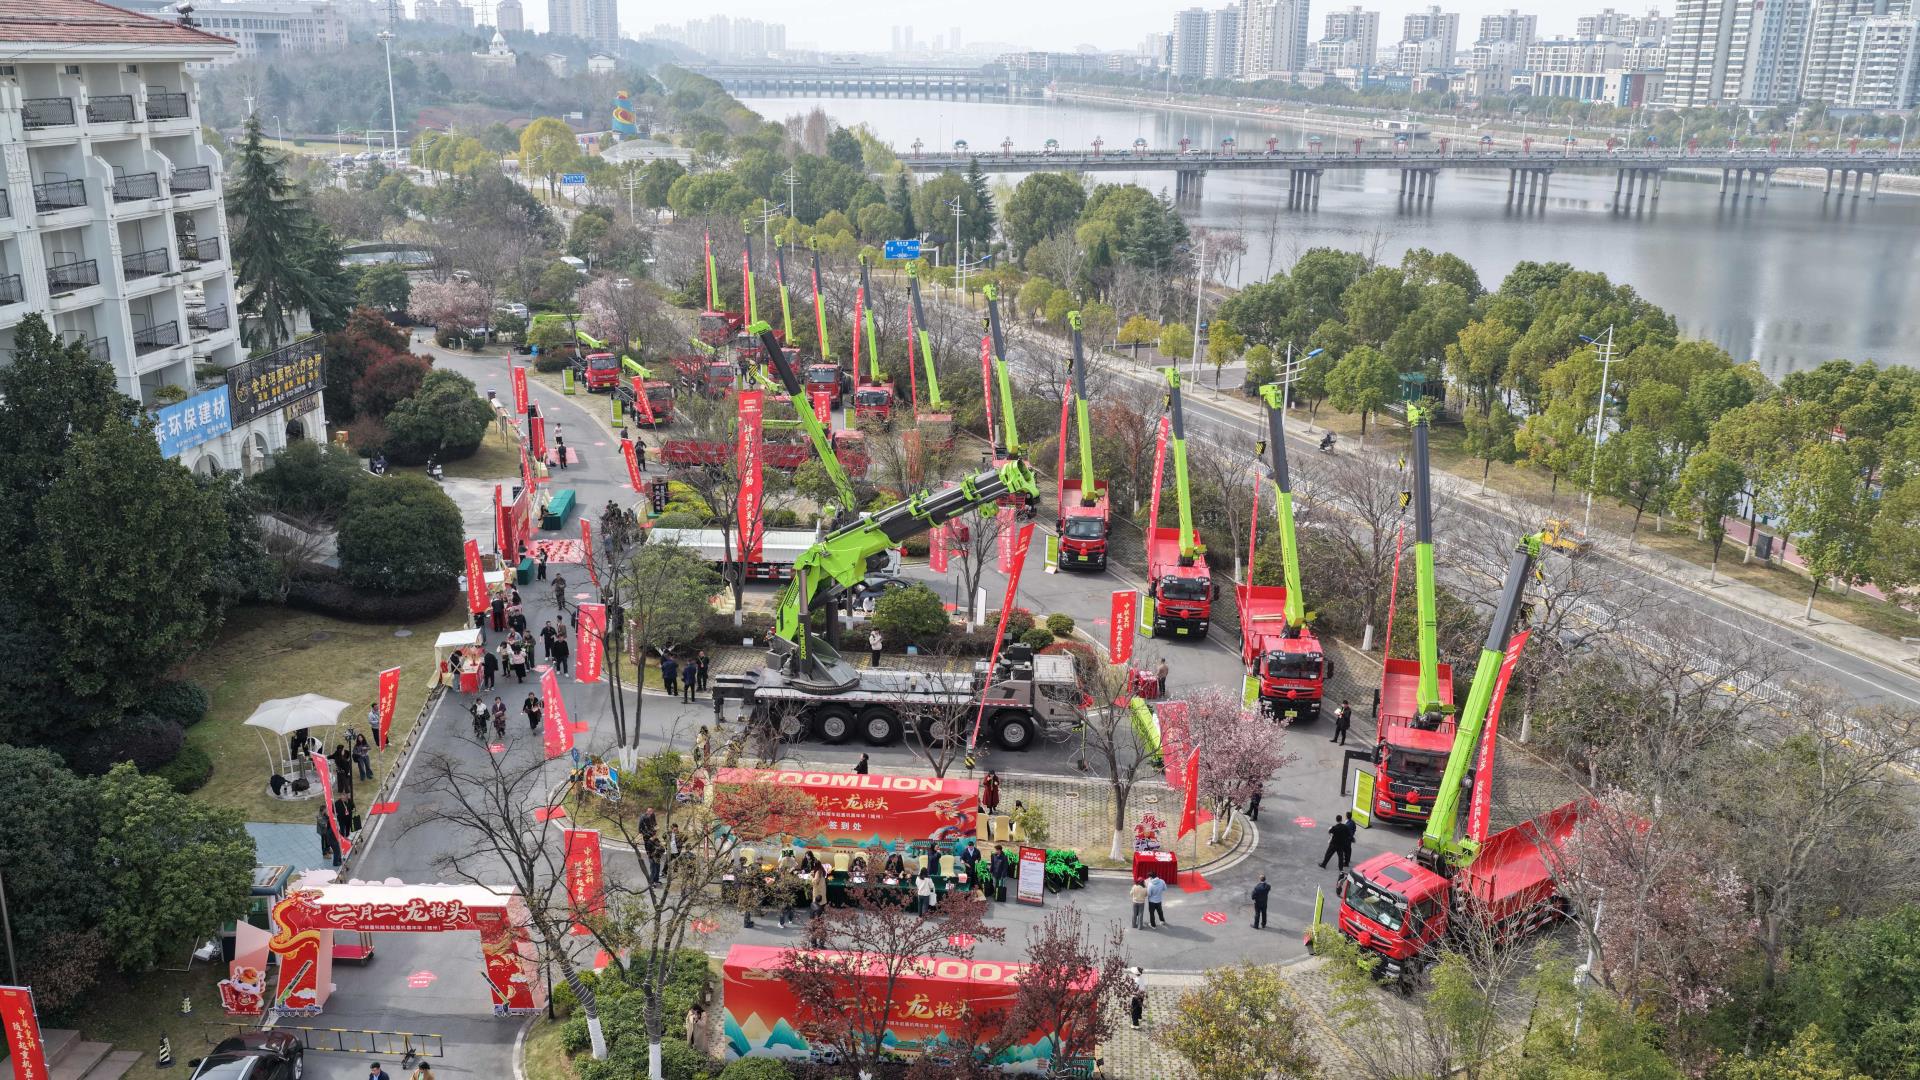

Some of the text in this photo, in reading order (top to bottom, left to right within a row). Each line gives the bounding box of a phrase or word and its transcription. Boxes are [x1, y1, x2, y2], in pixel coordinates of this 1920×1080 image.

[759, 772, 943, 792] ZOOMLION
[814, 793, 888, 811] 月二龙抬头
[829, 820, 862, 831] 签到处
[329, 900, 469, 922] 二月二龙抬头
